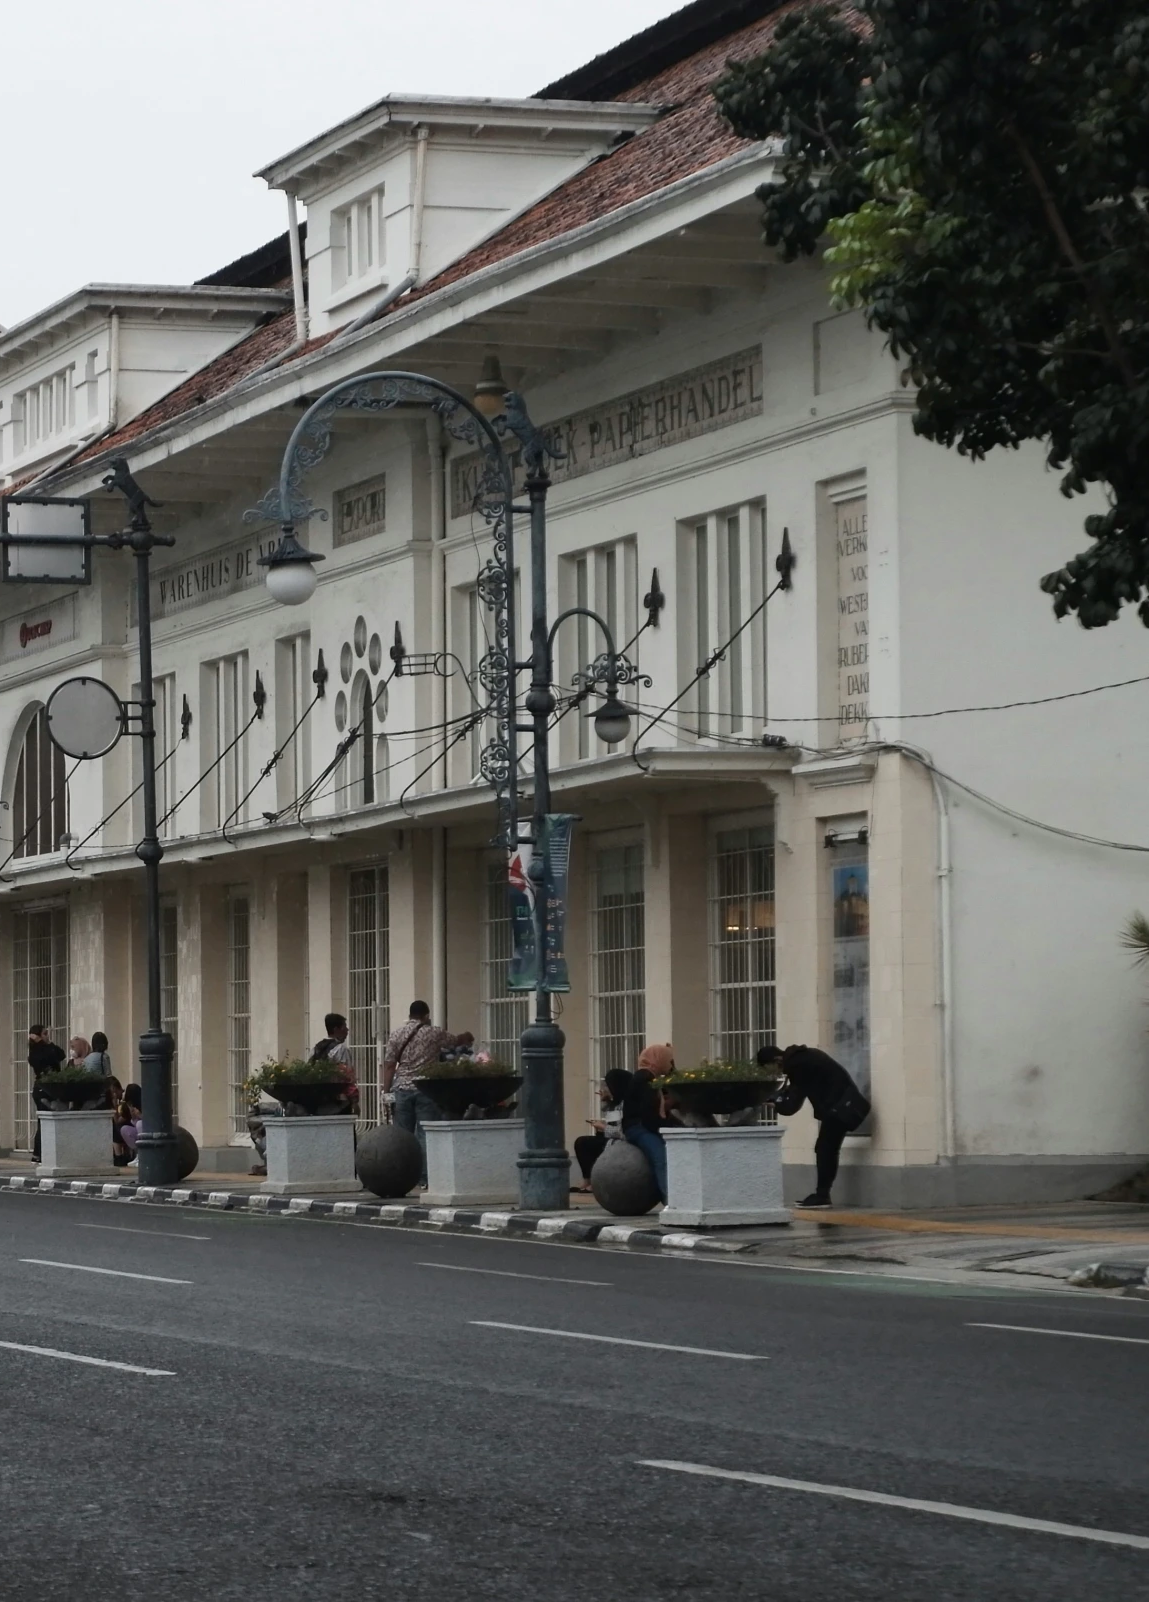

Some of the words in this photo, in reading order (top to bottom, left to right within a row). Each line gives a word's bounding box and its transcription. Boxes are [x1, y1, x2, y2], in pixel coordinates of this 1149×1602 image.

[160, 557, 230, 604] WARENHUIS
[236, 549, 252, 580] DE
[847, 672, 869, 695] DAK
